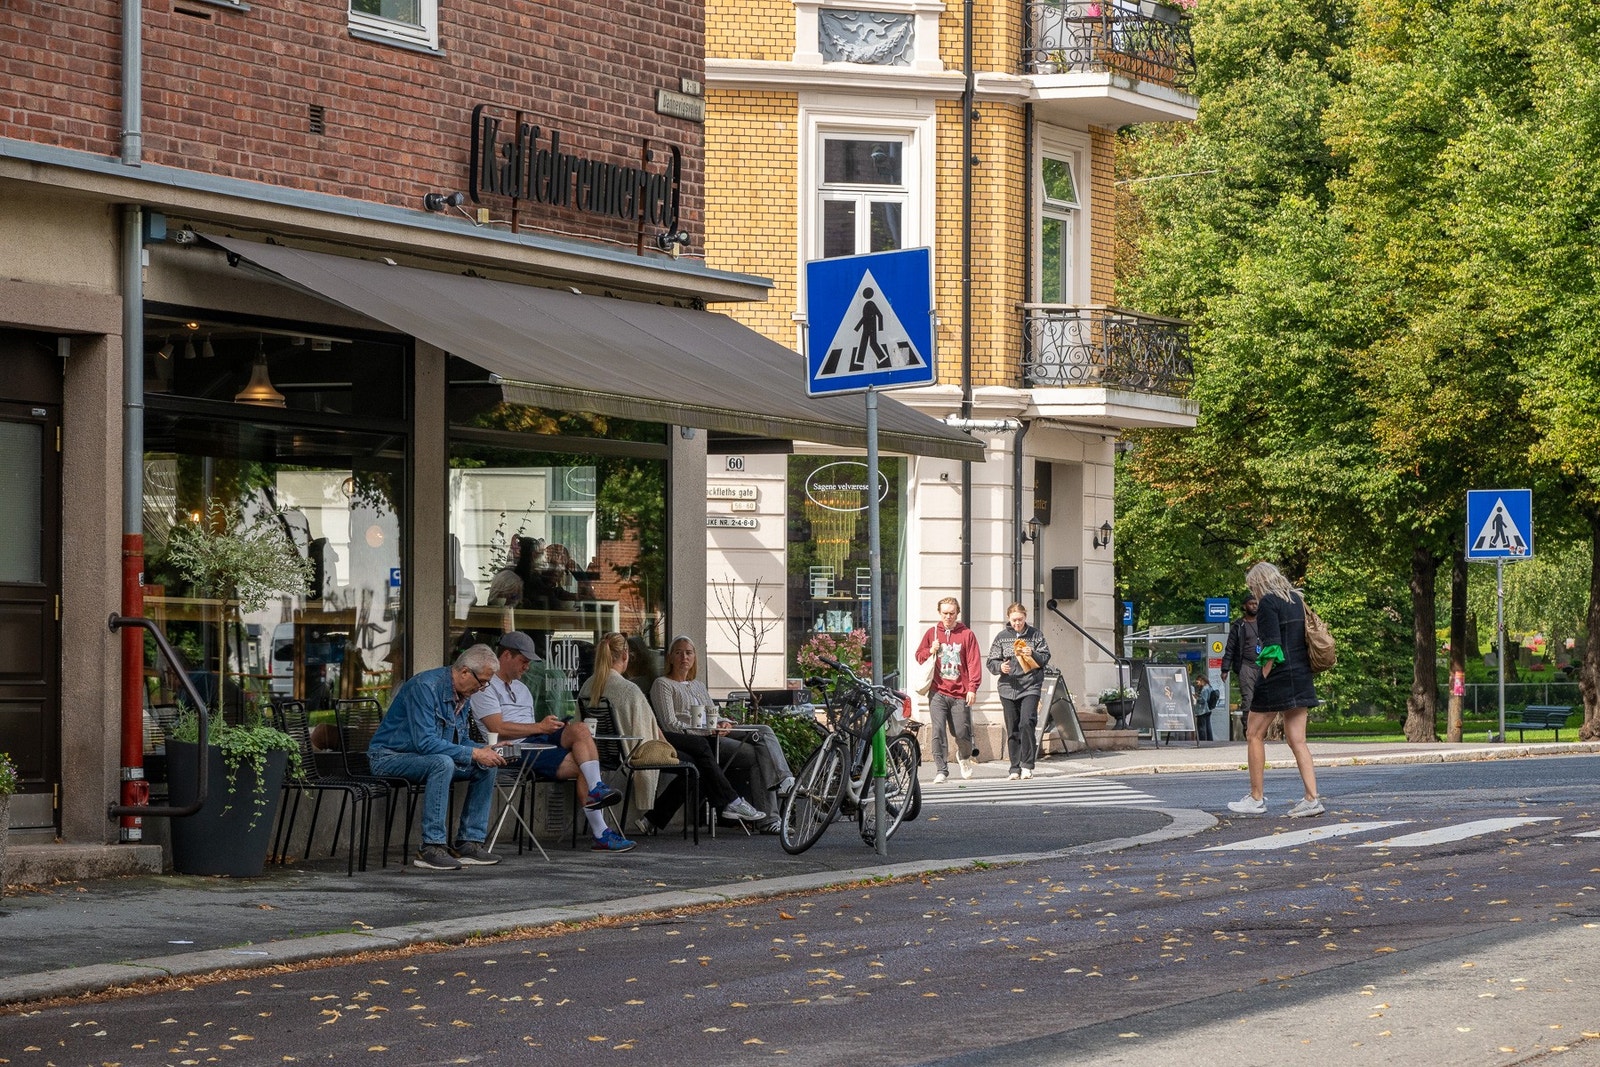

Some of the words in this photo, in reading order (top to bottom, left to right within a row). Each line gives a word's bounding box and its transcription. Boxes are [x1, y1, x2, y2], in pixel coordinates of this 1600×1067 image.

[481, 116, 675, 228] Kaffebrenneriet
[728, 457, 743, 469] 60
[813, 482, 837, 491] Sagene
[838, 482, 882, 490] velværeser
[738, 488, 753, 498] gate
[545, 634, 580, 670] Kaffe
